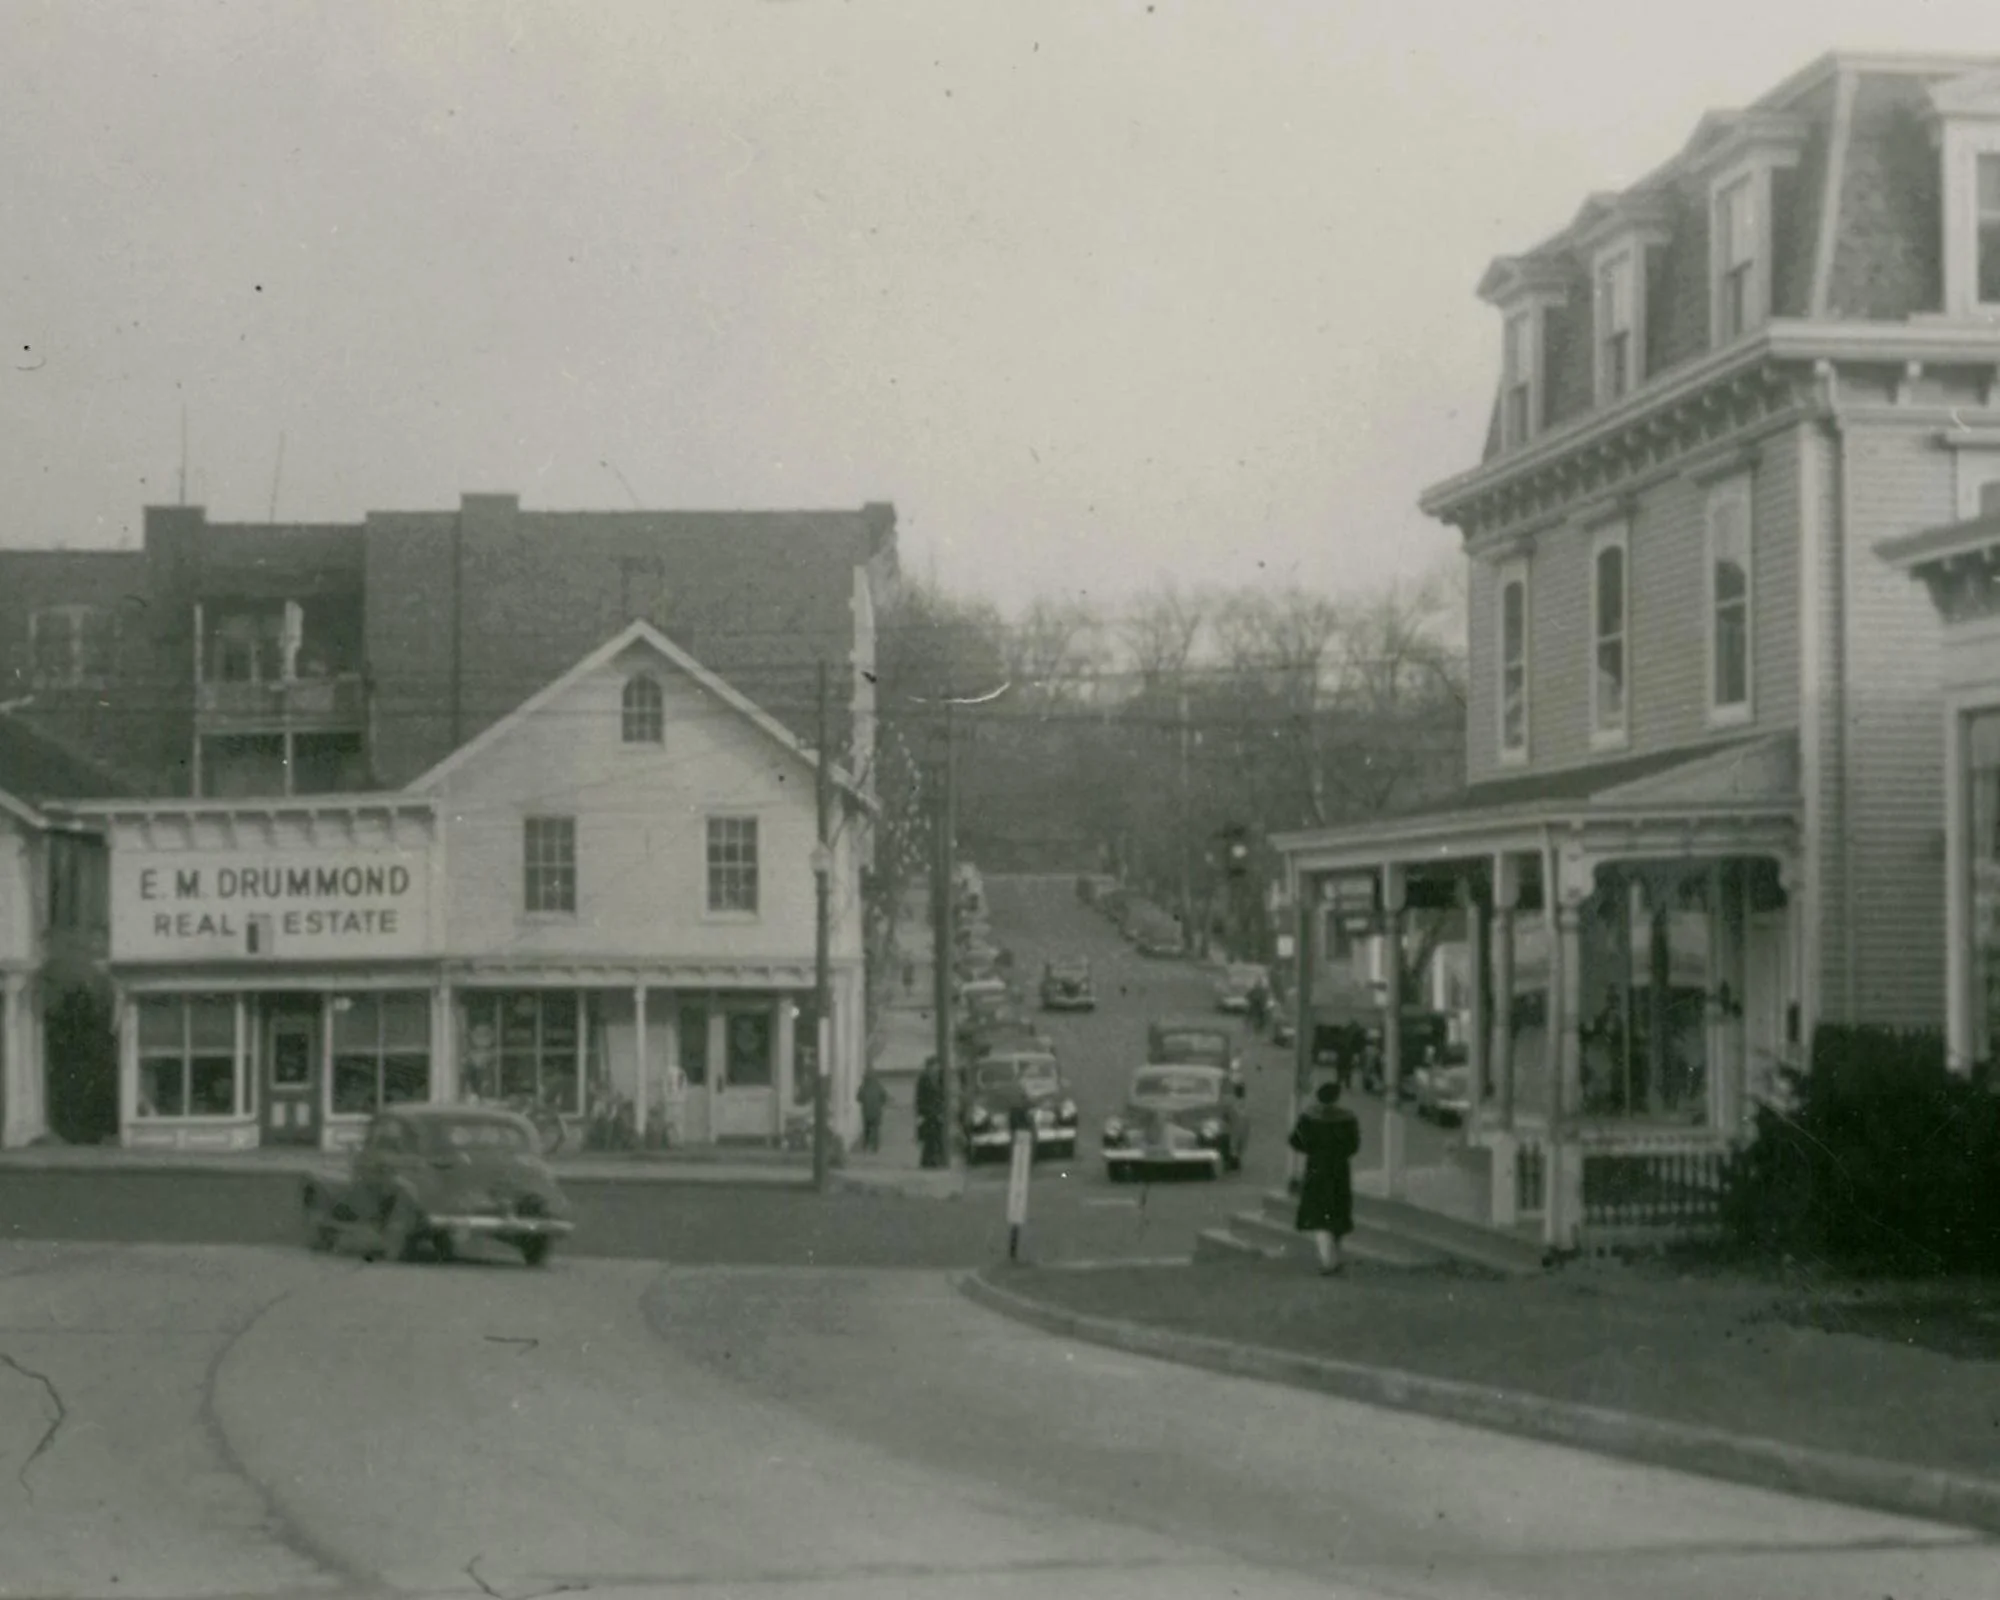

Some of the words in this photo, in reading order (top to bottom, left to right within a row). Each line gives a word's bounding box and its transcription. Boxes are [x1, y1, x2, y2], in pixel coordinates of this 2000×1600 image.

[218, 865, 410, 898] DRUMMOND
[154, 911, 237, 936] REAL
[283, 908, 398, 934] ESTATE
